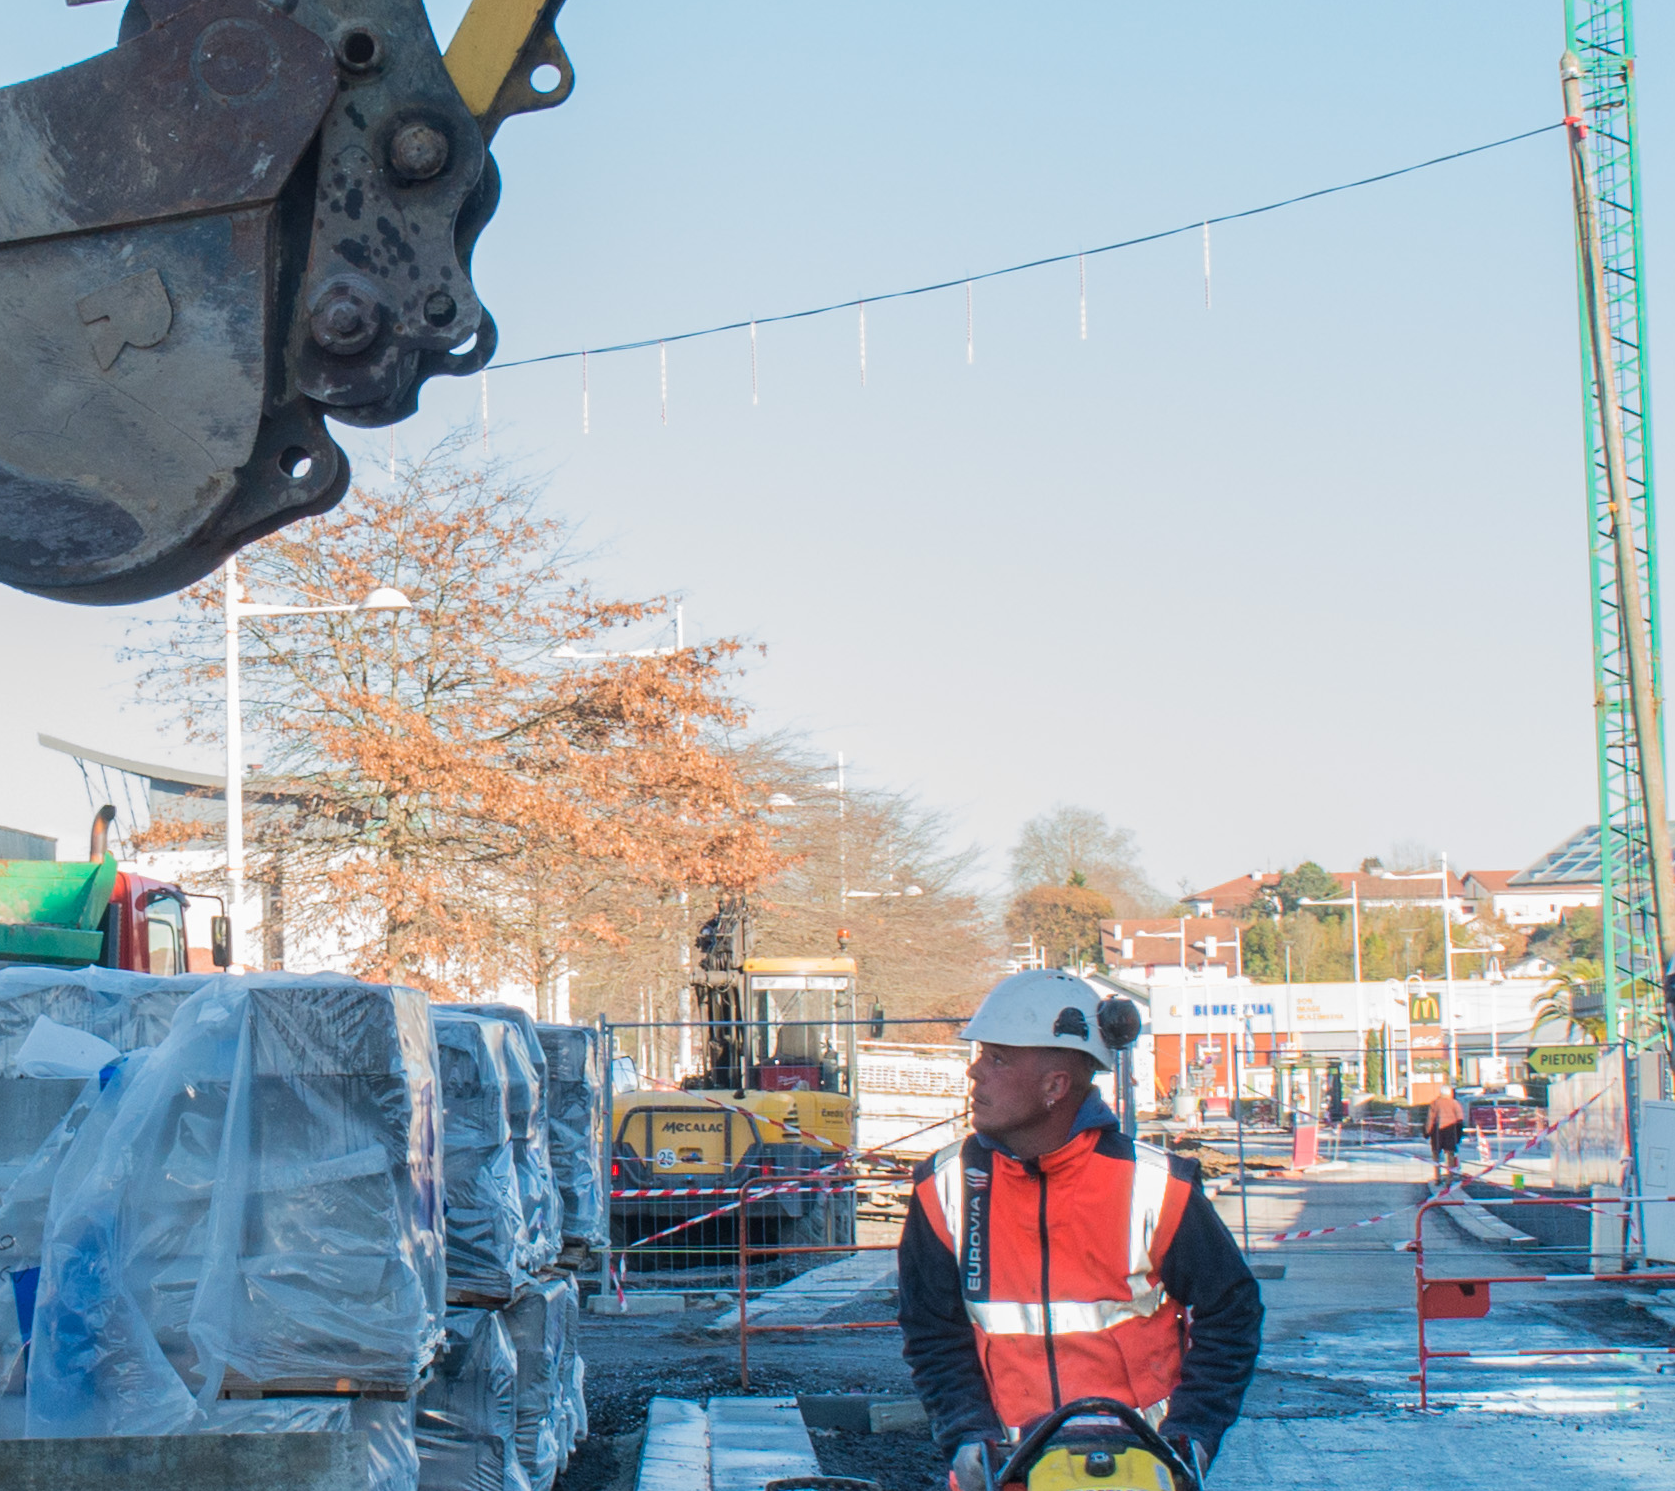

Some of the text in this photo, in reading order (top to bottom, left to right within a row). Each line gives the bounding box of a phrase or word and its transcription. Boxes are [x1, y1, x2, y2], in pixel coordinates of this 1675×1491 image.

[1540, 1053, 1594, 1066] PIETONS
[659, 1151, 674, 1165] 25
[967, 1196, 982, 1291] EUROVIA
